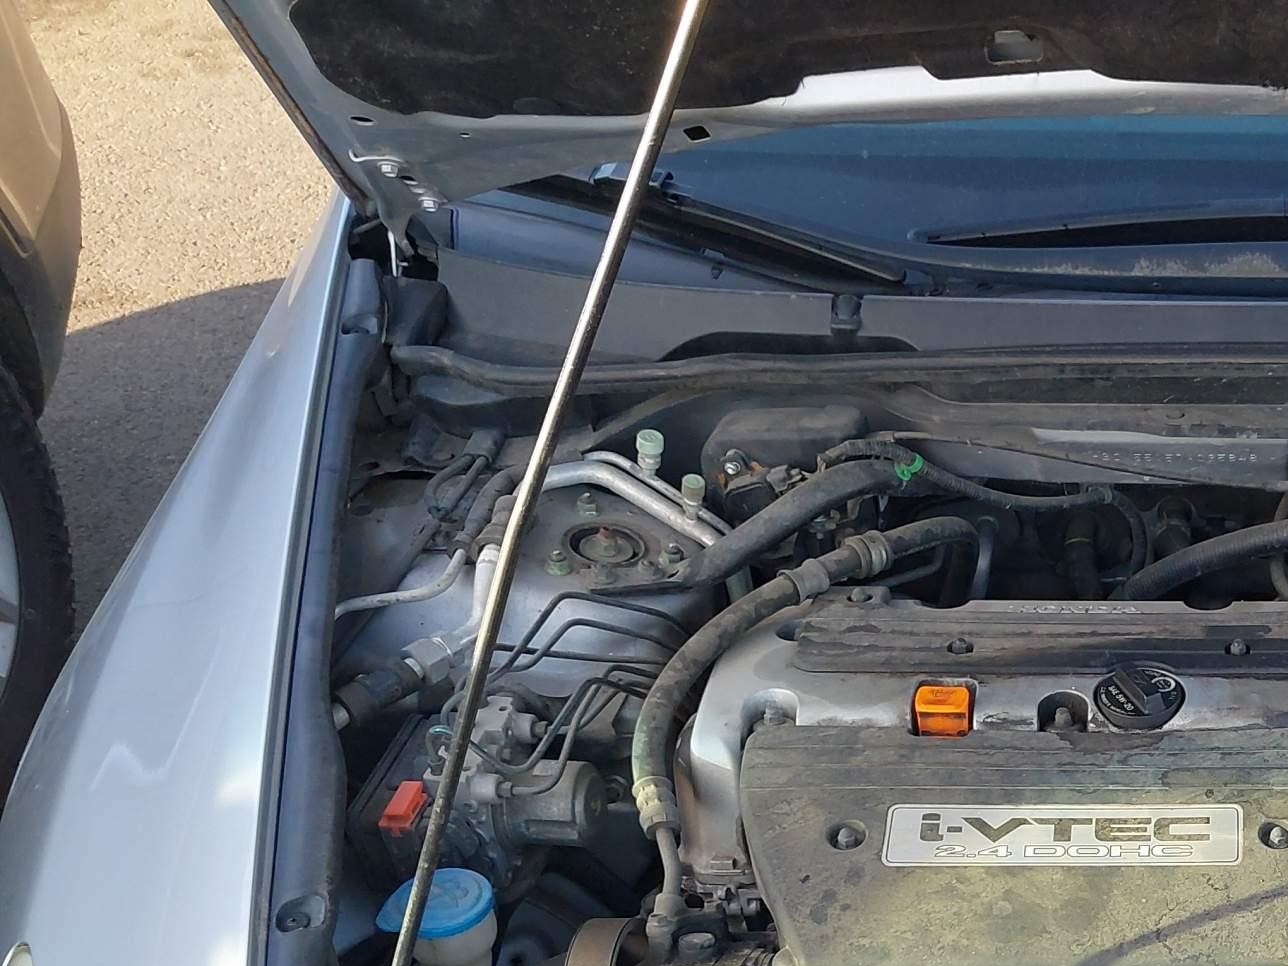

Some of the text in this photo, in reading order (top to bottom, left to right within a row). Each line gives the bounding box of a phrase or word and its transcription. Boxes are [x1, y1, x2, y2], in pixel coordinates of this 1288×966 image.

[919, 812, 1210, 842] i-VTEC
[934, 845, 1194, 858] 2.4 DOHC
